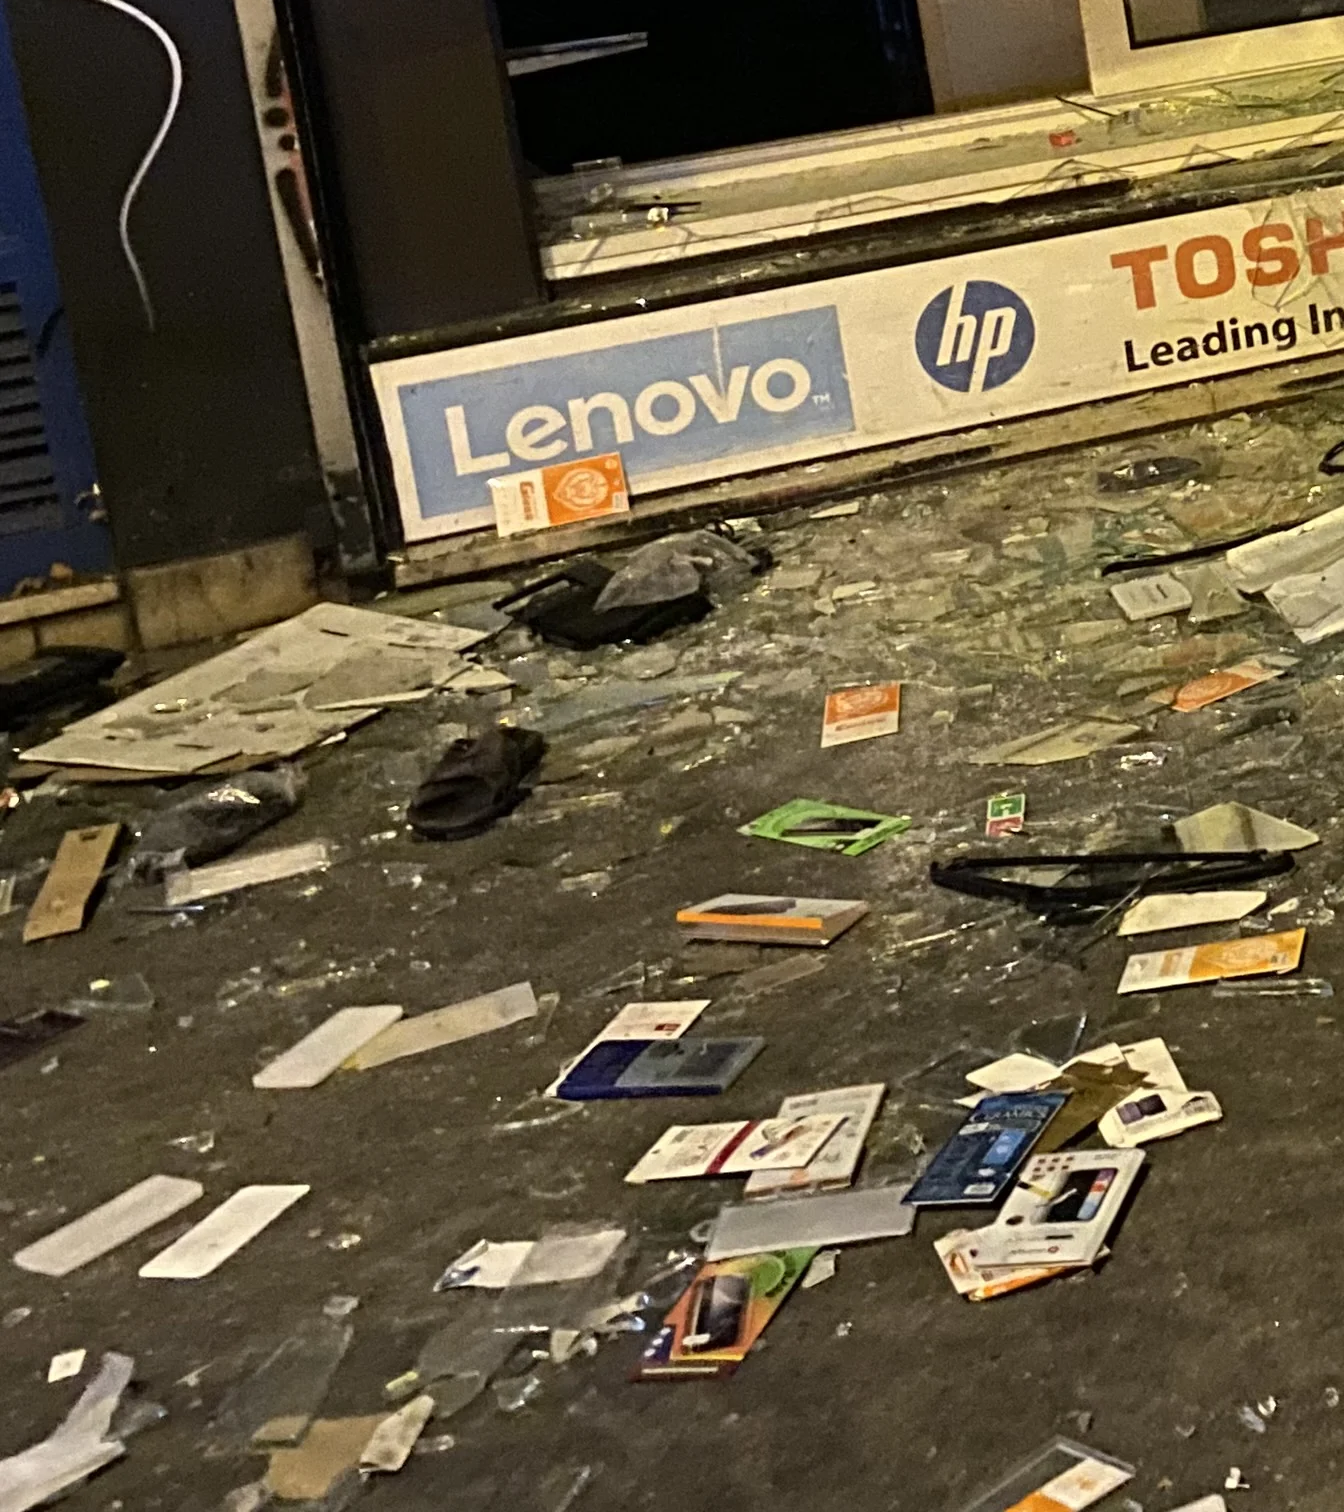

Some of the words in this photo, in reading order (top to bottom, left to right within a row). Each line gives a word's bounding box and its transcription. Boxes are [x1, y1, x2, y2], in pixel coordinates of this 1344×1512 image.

[935, 280, 1019, 393] hp
[1123, 311, 1299, 373] Leading
[443, 357, 812, 478] Lenovo
